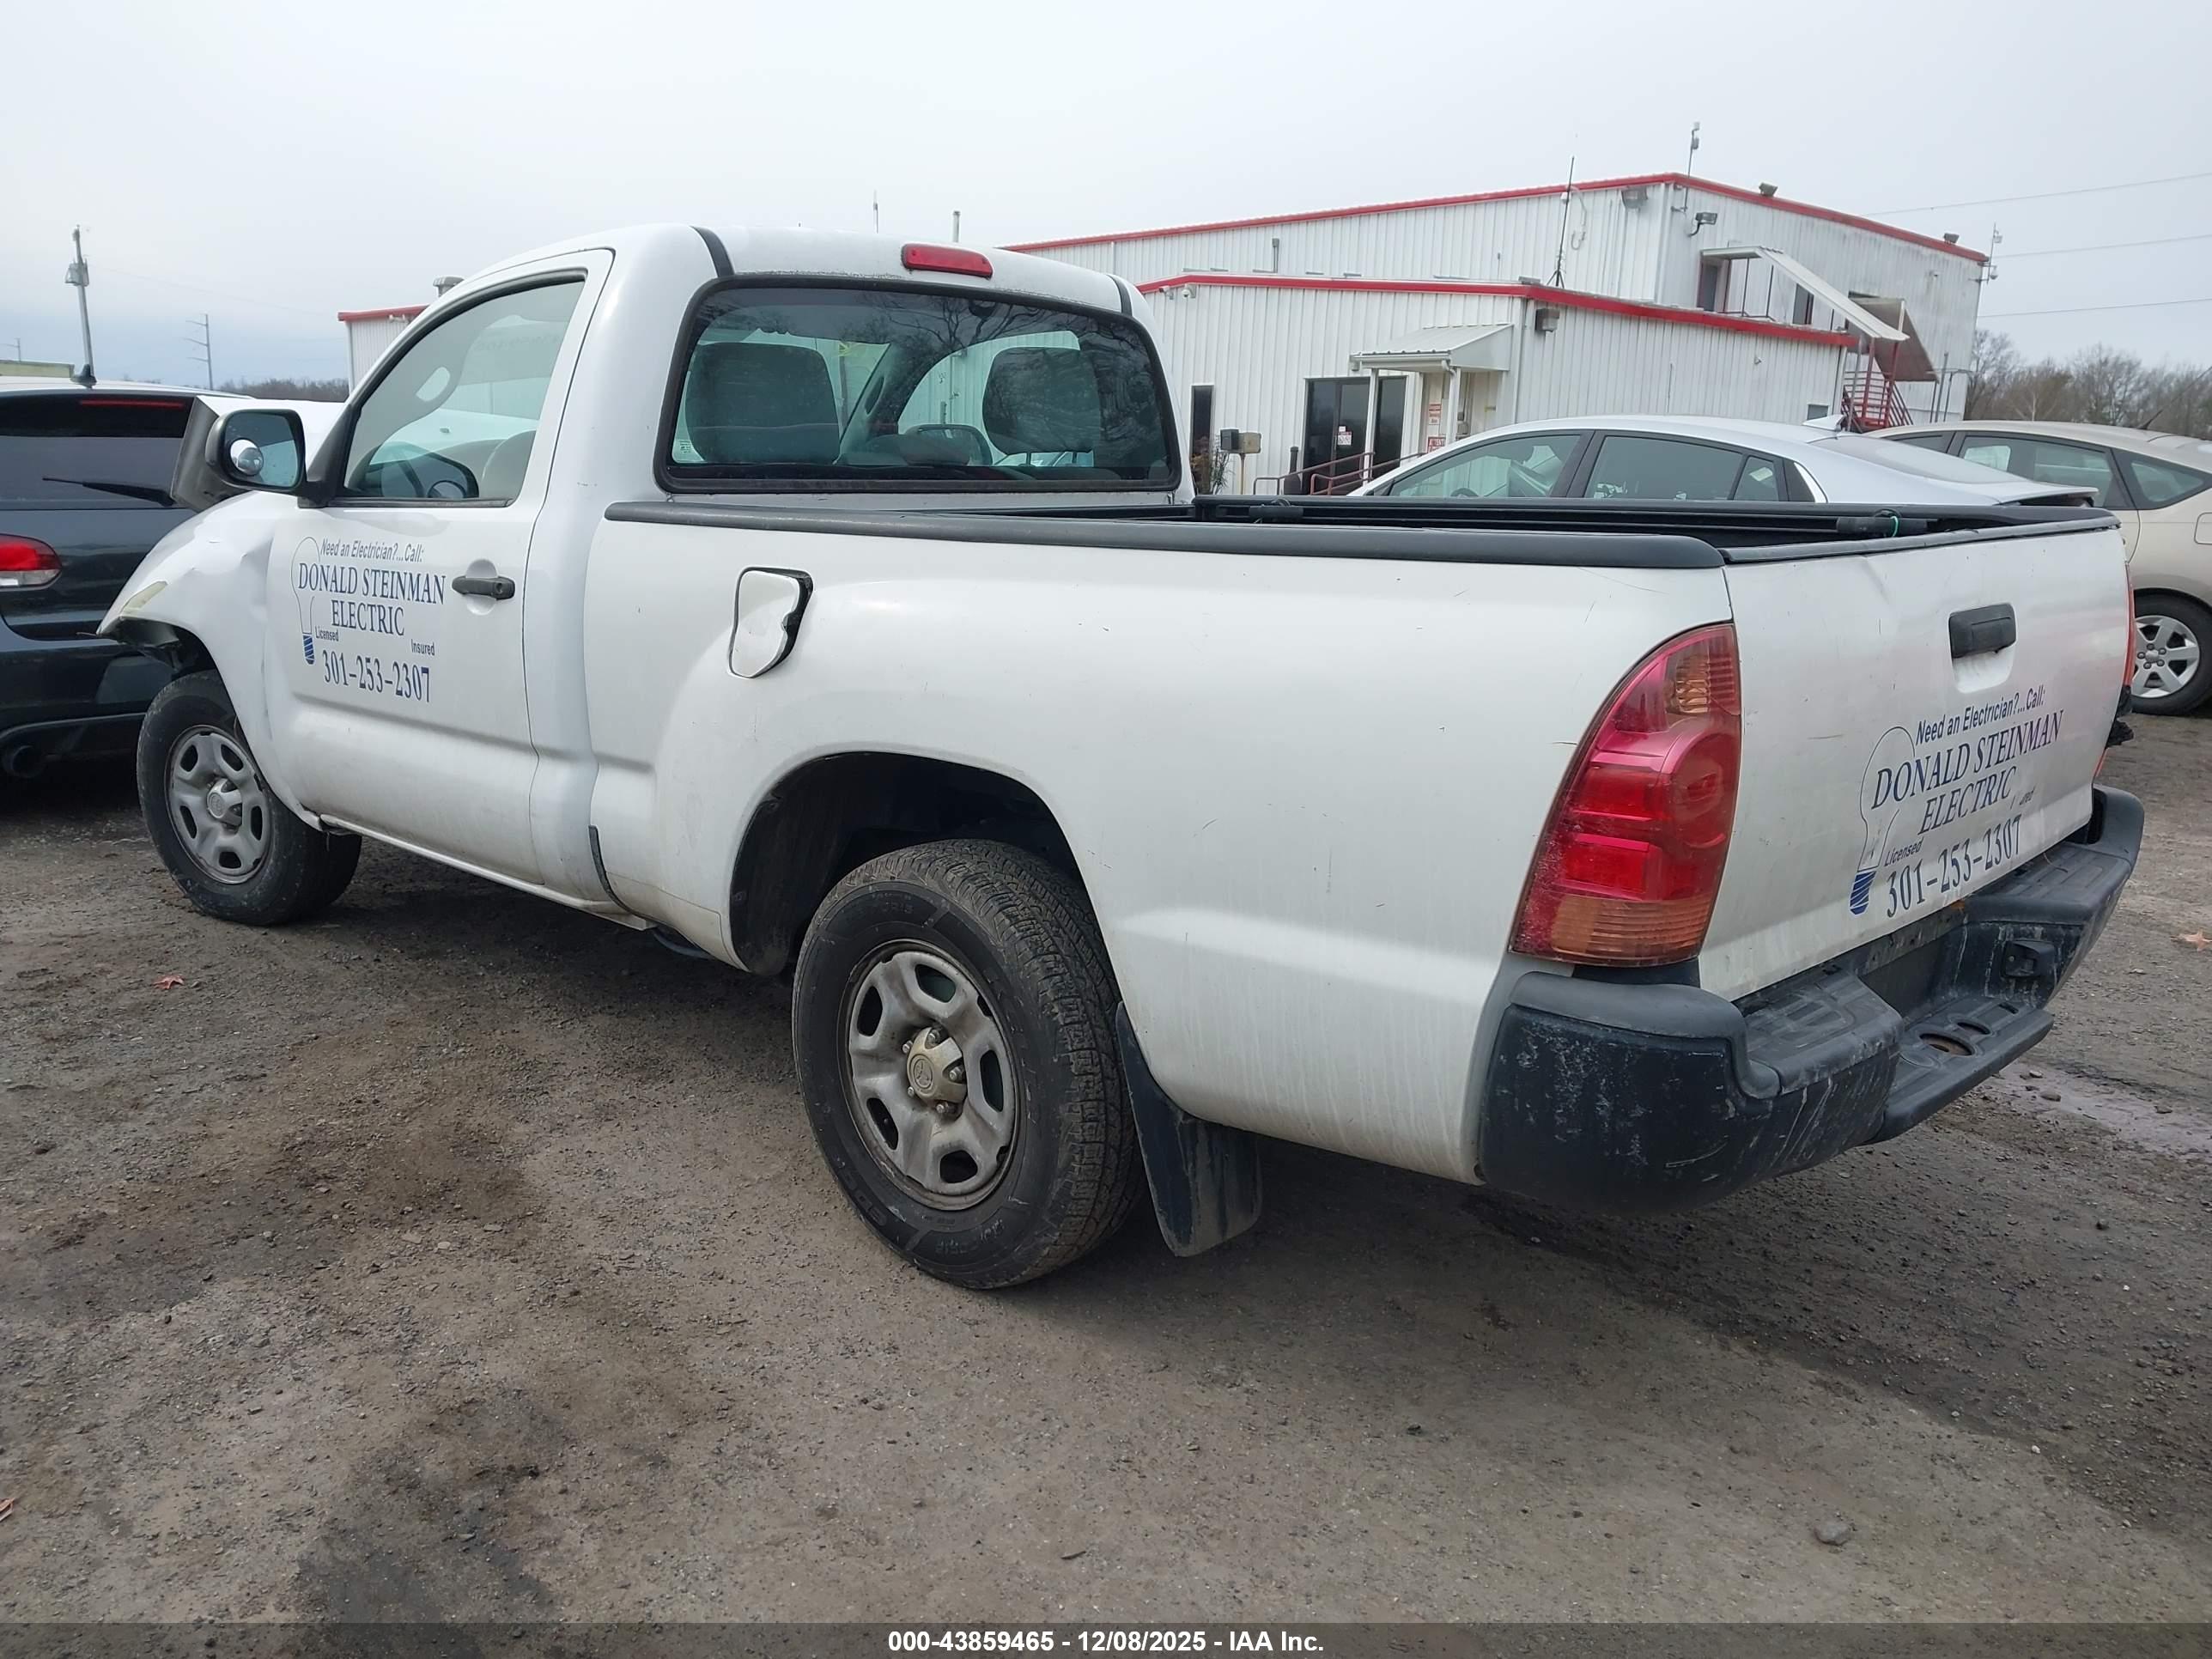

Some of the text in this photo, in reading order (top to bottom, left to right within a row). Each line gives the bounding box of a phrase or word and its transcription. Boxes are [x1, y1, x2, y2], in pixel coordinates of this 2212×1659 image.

[320, 538, 339, 556] Need
[340, 544, 349, 556] an
[298, 562, 446, 605] DONALD STEINMAN
[315, 626, 339, 642] Licensed
[331, 599, 404, 635] ELECTRIC
[411, 639, 435, 656] Insured
[323, 650, 429, 702] 301-253-2307
[1916, 714, 1945, 745] Need
[1947, 717, 1960, 736] an
[1871, 710, 2063, 810] DONALD STEINMAN
[1917, 766, 2016, 836] ELECTRIC
[1884, 837, 1923, 867] Licensed
[1887, 814, 2022, 918] 301-253-2307
